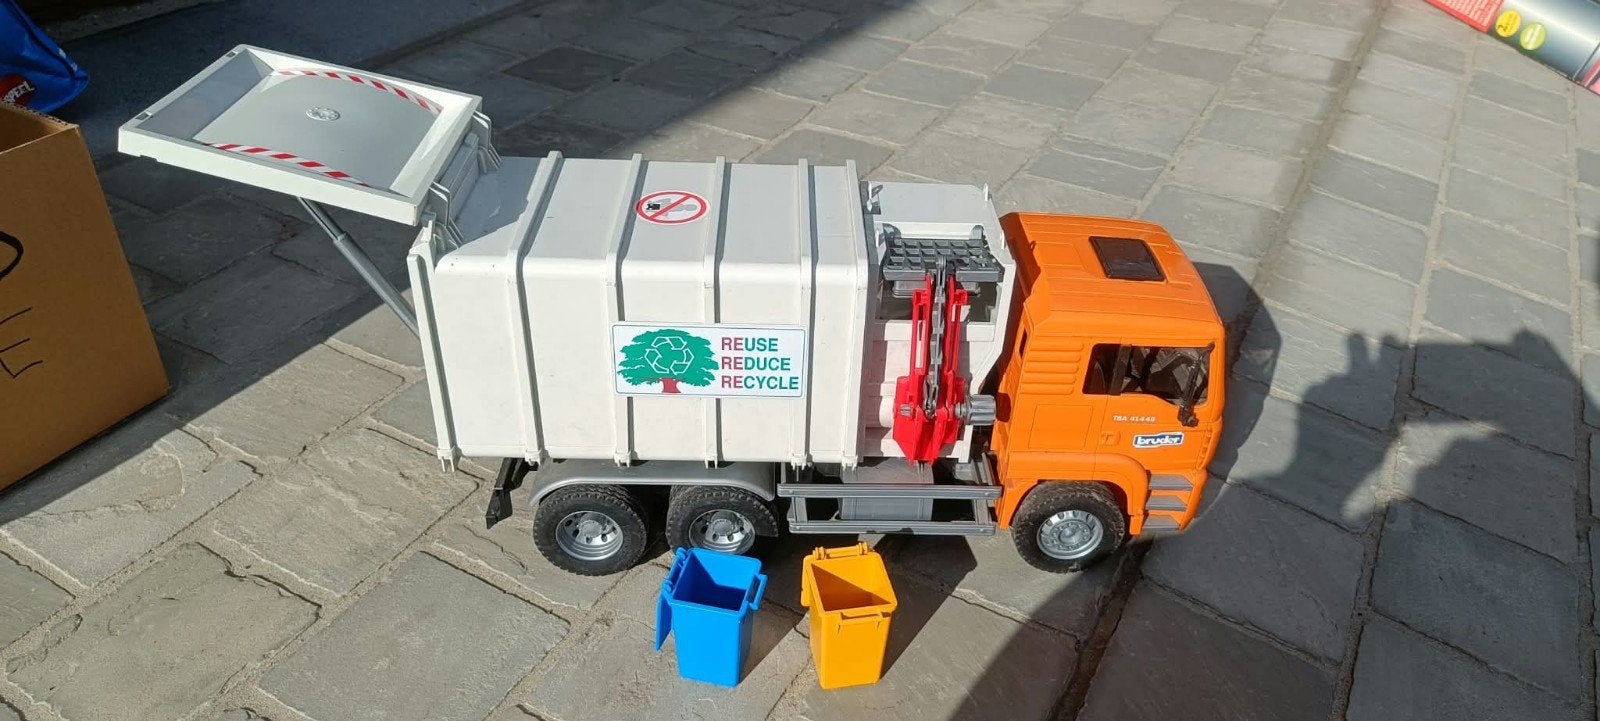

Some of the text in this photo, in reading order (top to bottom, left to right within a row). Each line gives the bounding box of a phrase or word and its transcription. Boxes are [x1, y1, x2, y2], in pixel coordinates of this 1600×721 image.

[721, 336, 778, 352] REUSE
[721, 356, 791, 371] REDUCE
[721, 375, 799, 390] RECYCLE
[1136, 435, 1181, 445] bruder
